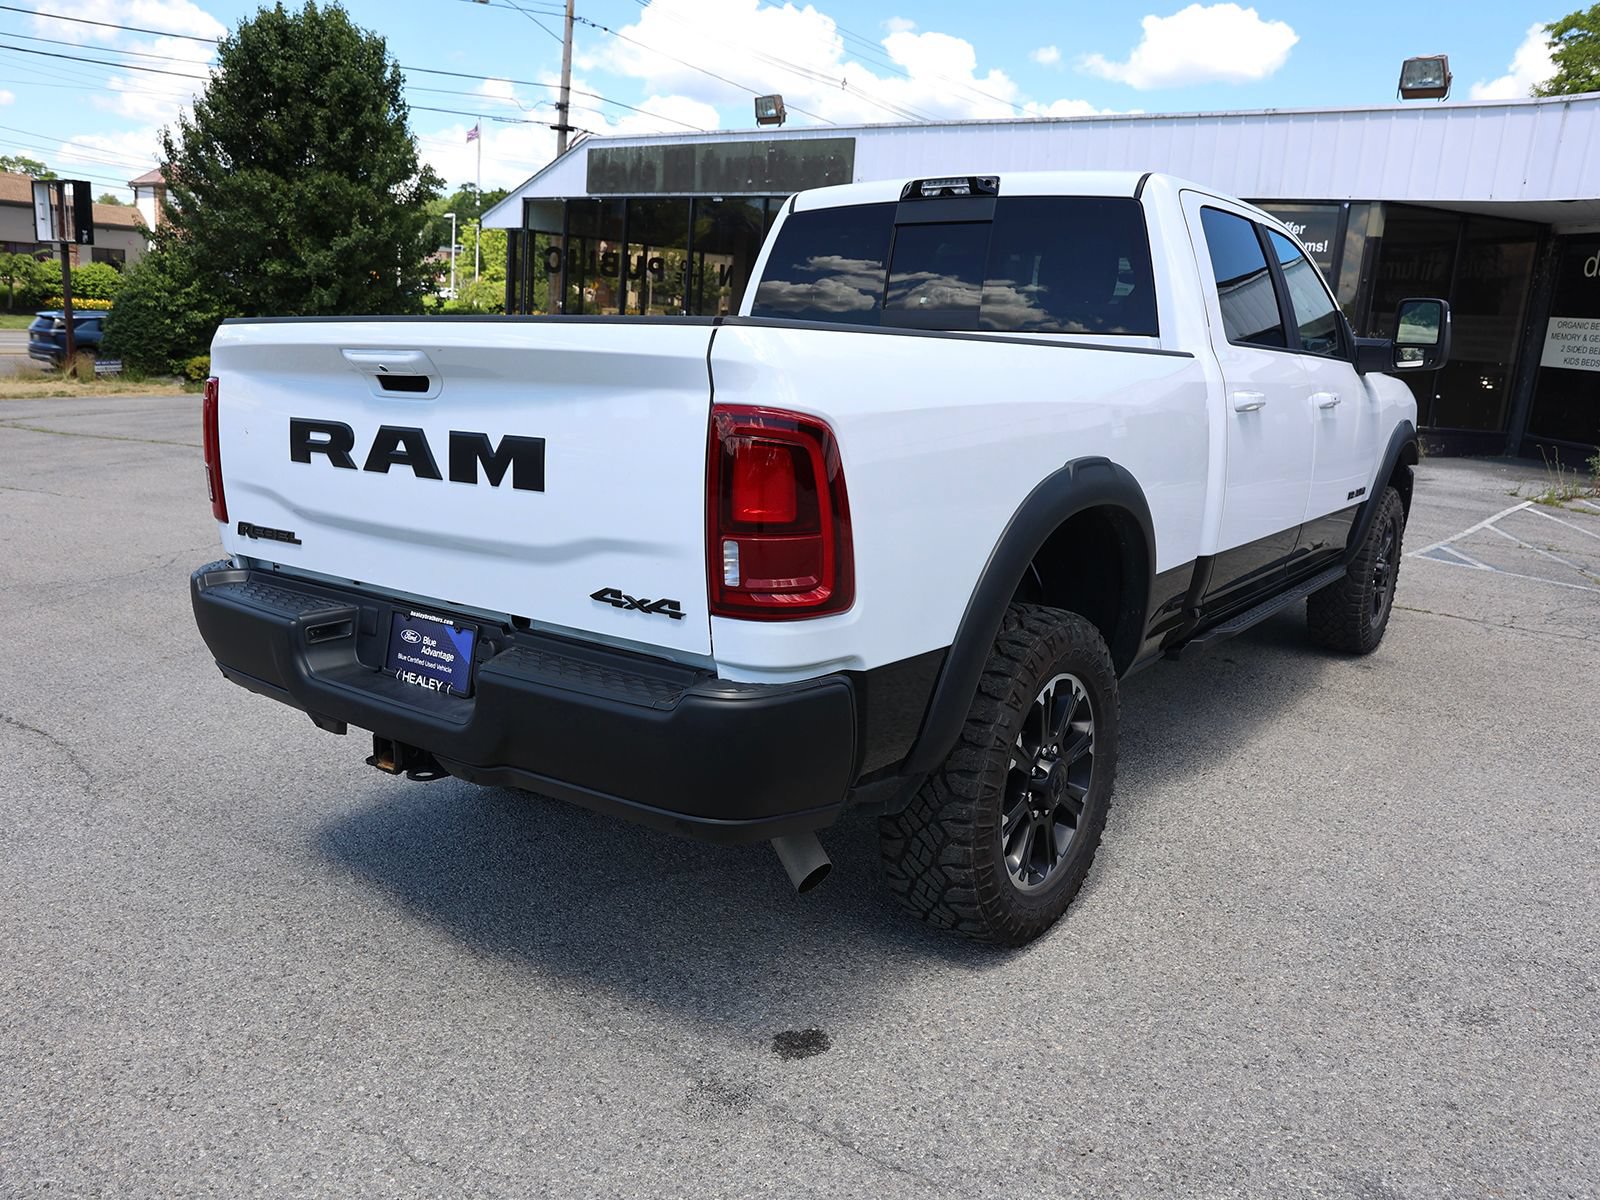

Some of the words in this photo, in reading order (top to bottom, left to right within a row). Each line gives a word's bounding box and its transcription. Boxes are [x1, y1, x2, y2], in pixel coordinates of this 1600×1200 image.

[1557, 320, 1589, 330] ORGANIC
[1551, 332, 1581, 341] MEMORY
[1560, 344, 1566, 353] 2
[1566, 345, 1587, 354] SIDED
[1563, 357, 1579, 366] KIDS
[290, 416, 546, 493] RAM
[422, 635, 437, 647] Blue
[421, 646, 454, 662] Advantage
[398, 652, 407, 661] Blue
[407, 656, 425, 665] Certified
[425, 661, 436, 669] Used
[436, 664, 452, 673] Vehicle
[402, 670, 443, 691] HEALEY
